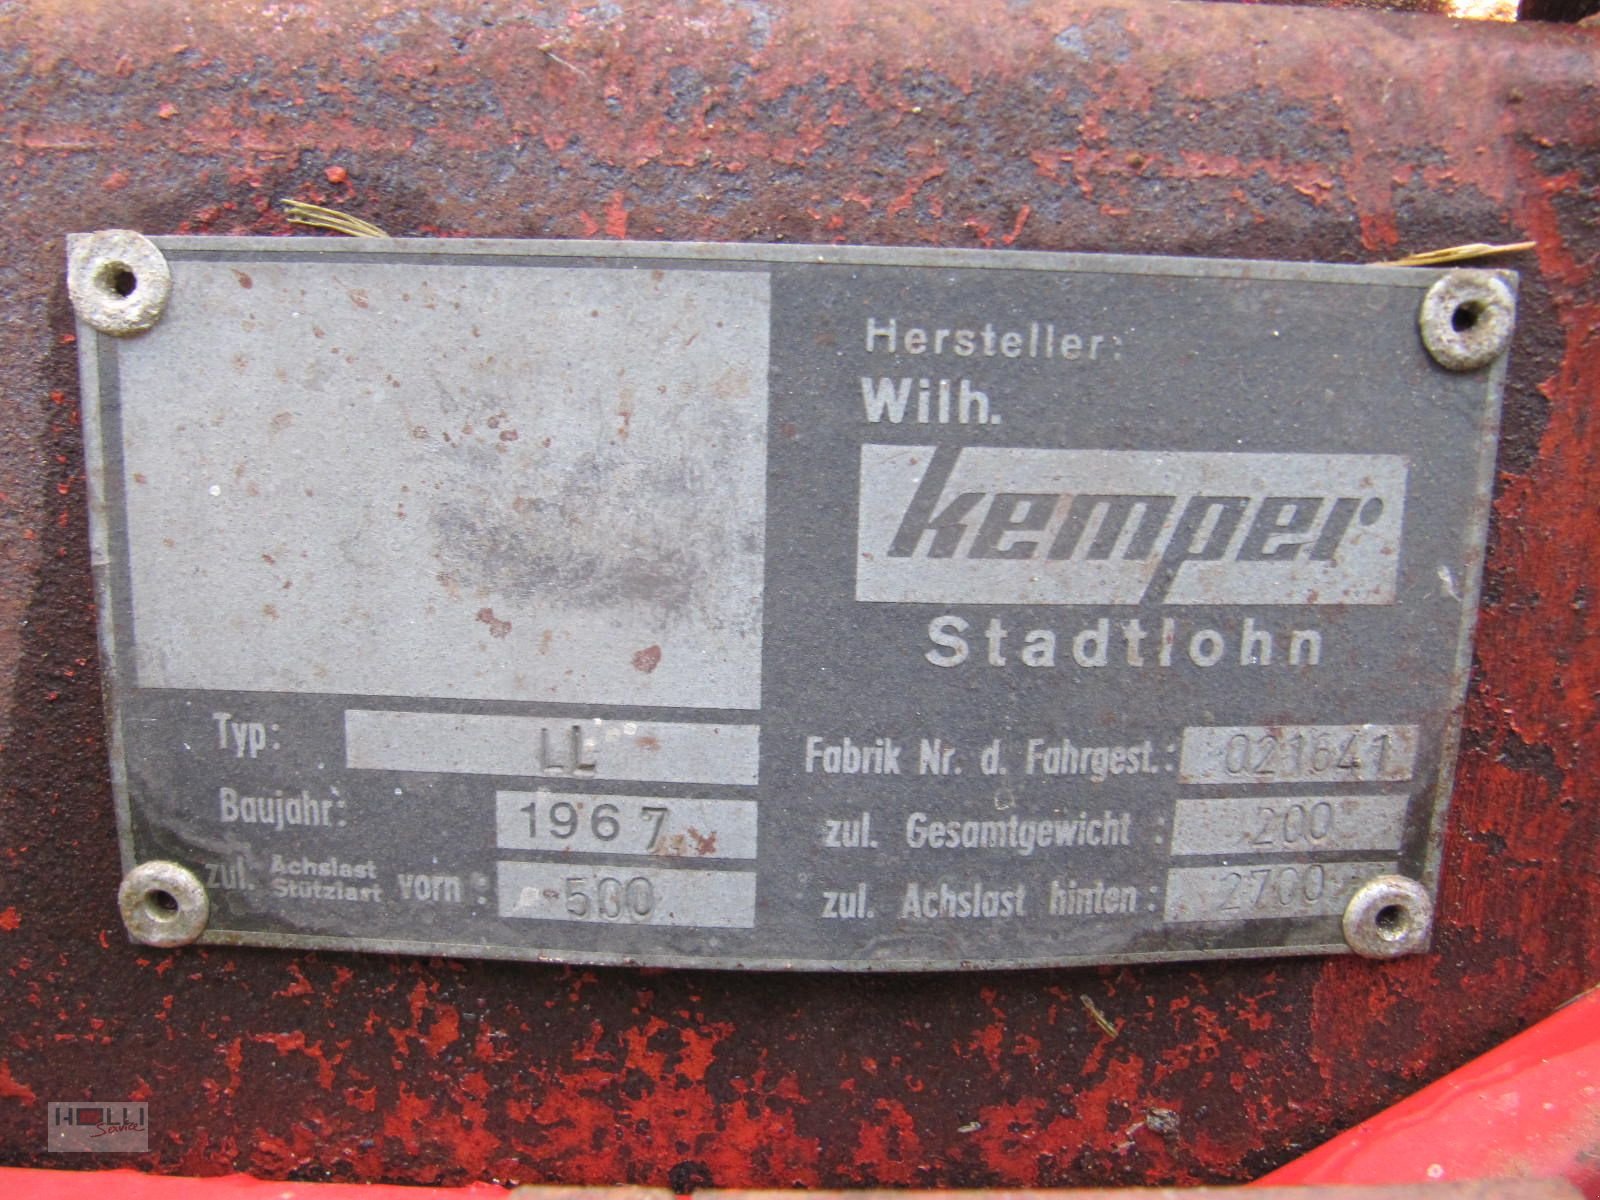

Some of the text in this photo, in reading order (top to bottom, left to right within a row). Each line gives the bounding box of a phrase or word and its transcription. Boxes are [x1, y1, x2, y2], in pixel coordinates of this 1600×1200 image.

[865, 318, 1122, 362] Hersteller:
[860, 376, 1002, 425] Wilh.
[925, 615, 1323, 668] Stadtlohn
[213, 711, 281, 758] Typ:
[805, 736, 901, 775] Fabrik
[919, 738, 962, 775] Nr.
[980, 739, 1007, 775] d.
[219, 787, 670, 853] Baujahr: 1967
[824, 812, 879, 849] zul.
[906, 811, 1132, 856] Gesamtgewicht
[204, 855, 256, 891] zul.
[270, 853, 377, 880] Achslast
[564, 875, 656, 918] 500
[821, 883, 874, 919] zul.
[901, 882, 1027, 918] Achslast
